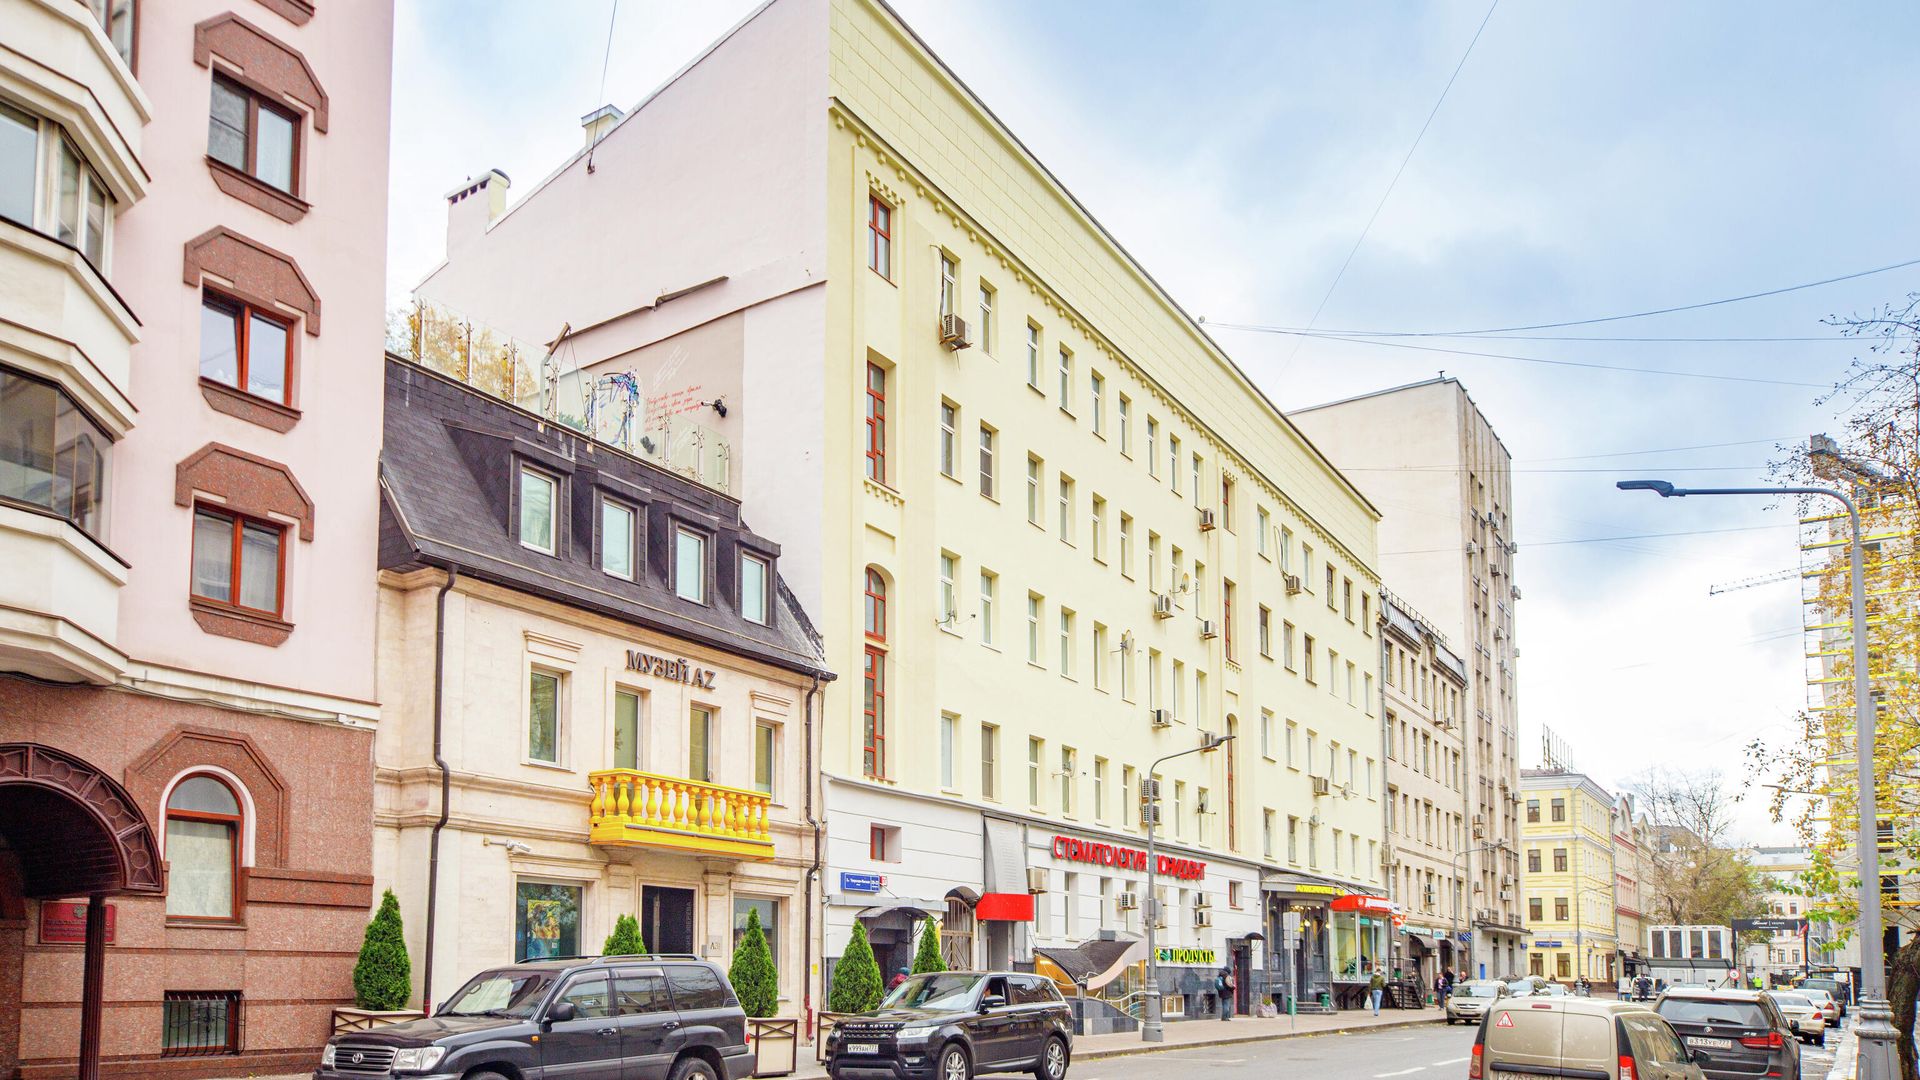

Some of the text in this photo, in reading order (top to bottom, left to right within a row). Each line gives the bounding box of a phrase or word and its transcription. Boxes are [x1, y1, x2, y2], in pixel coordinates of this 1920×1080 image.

[625, 649, 690, 683] МУЗЕЙ
[1053, 835, 1207, 881] СТОМАТОЛОГИЯ ЮНИДЕНТ
[1172, 948, 1216, 964] ПРОДУКТЫ
